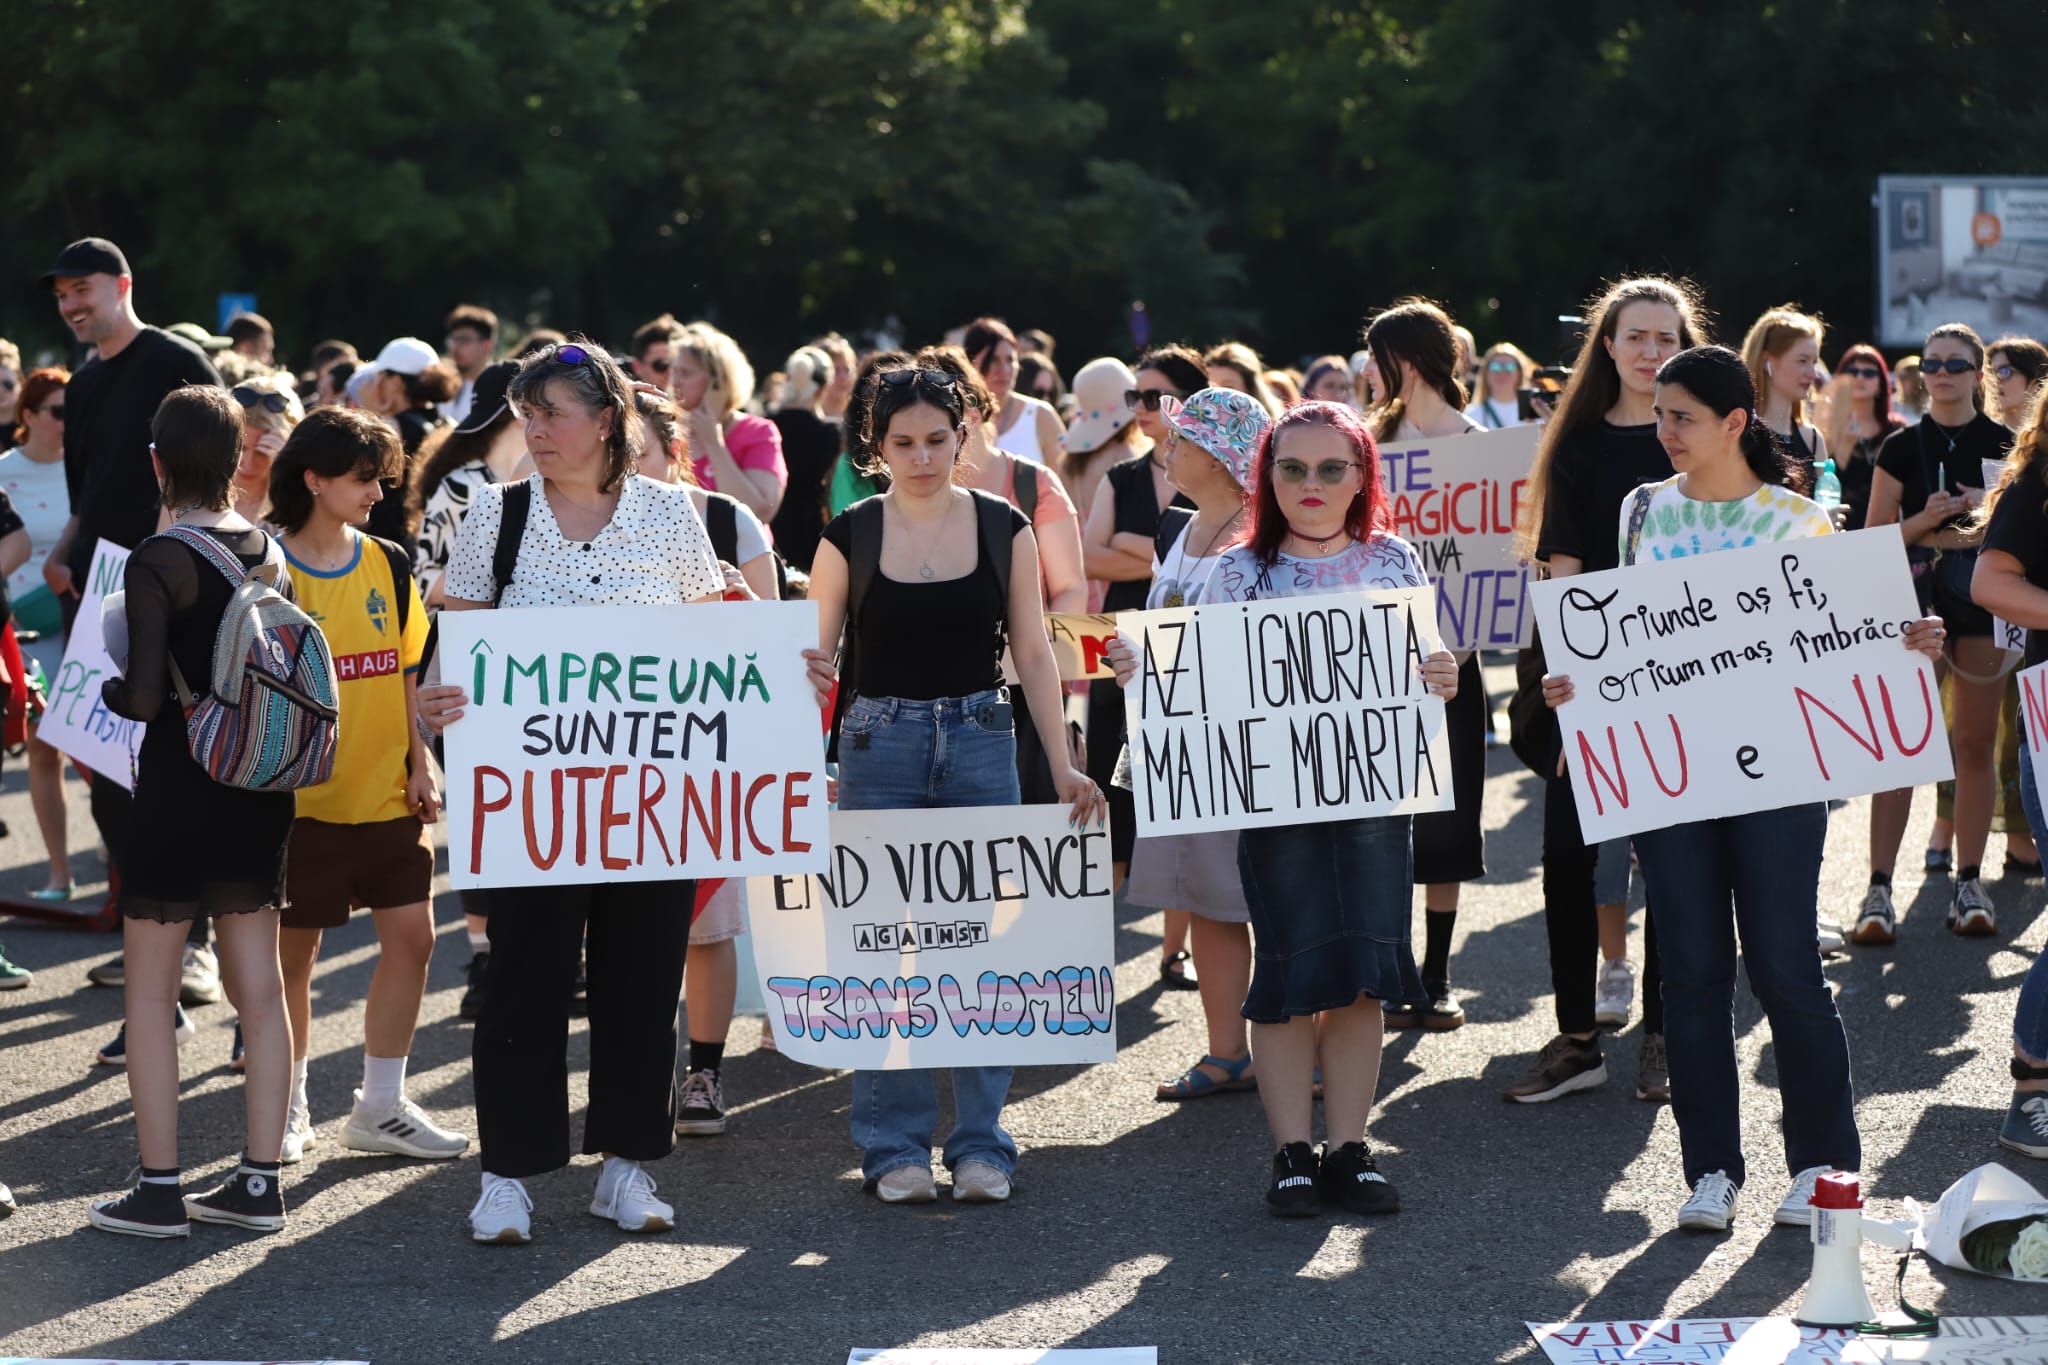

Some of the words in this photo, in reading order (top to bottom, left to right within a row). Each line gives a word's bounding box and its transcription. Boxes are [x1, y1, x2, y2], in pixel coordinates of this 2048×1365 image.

[1381, 449, 1433, 494] TE
[1428, 561, 1529, 649] NȚEI
[1559, 580, 1717, 660] Oriunde
[470, 638, 771, 706] ÎMPREUNĂ
[1599, 659, 1705, 702] oricum
[522, 710, 728, 763] SUNTEM
[1576, 713, 1689, 816] NU
[1736, 745, 1765, 780] e
[1794, 667, 1934, 781] NU
[470, 763, 814, 875] PUTERNICE
[885, 832, 1111, 903] VIOLENCE
[856, 923, 985, 950] AGAINST
[767, 975, 938, 1041] TRANS
[938, 966, 1115, 1038] WOMEN
[1277, 1175, 1313, 1190] PUMA
[1356, 1171, 1388, 1184] PUMA
